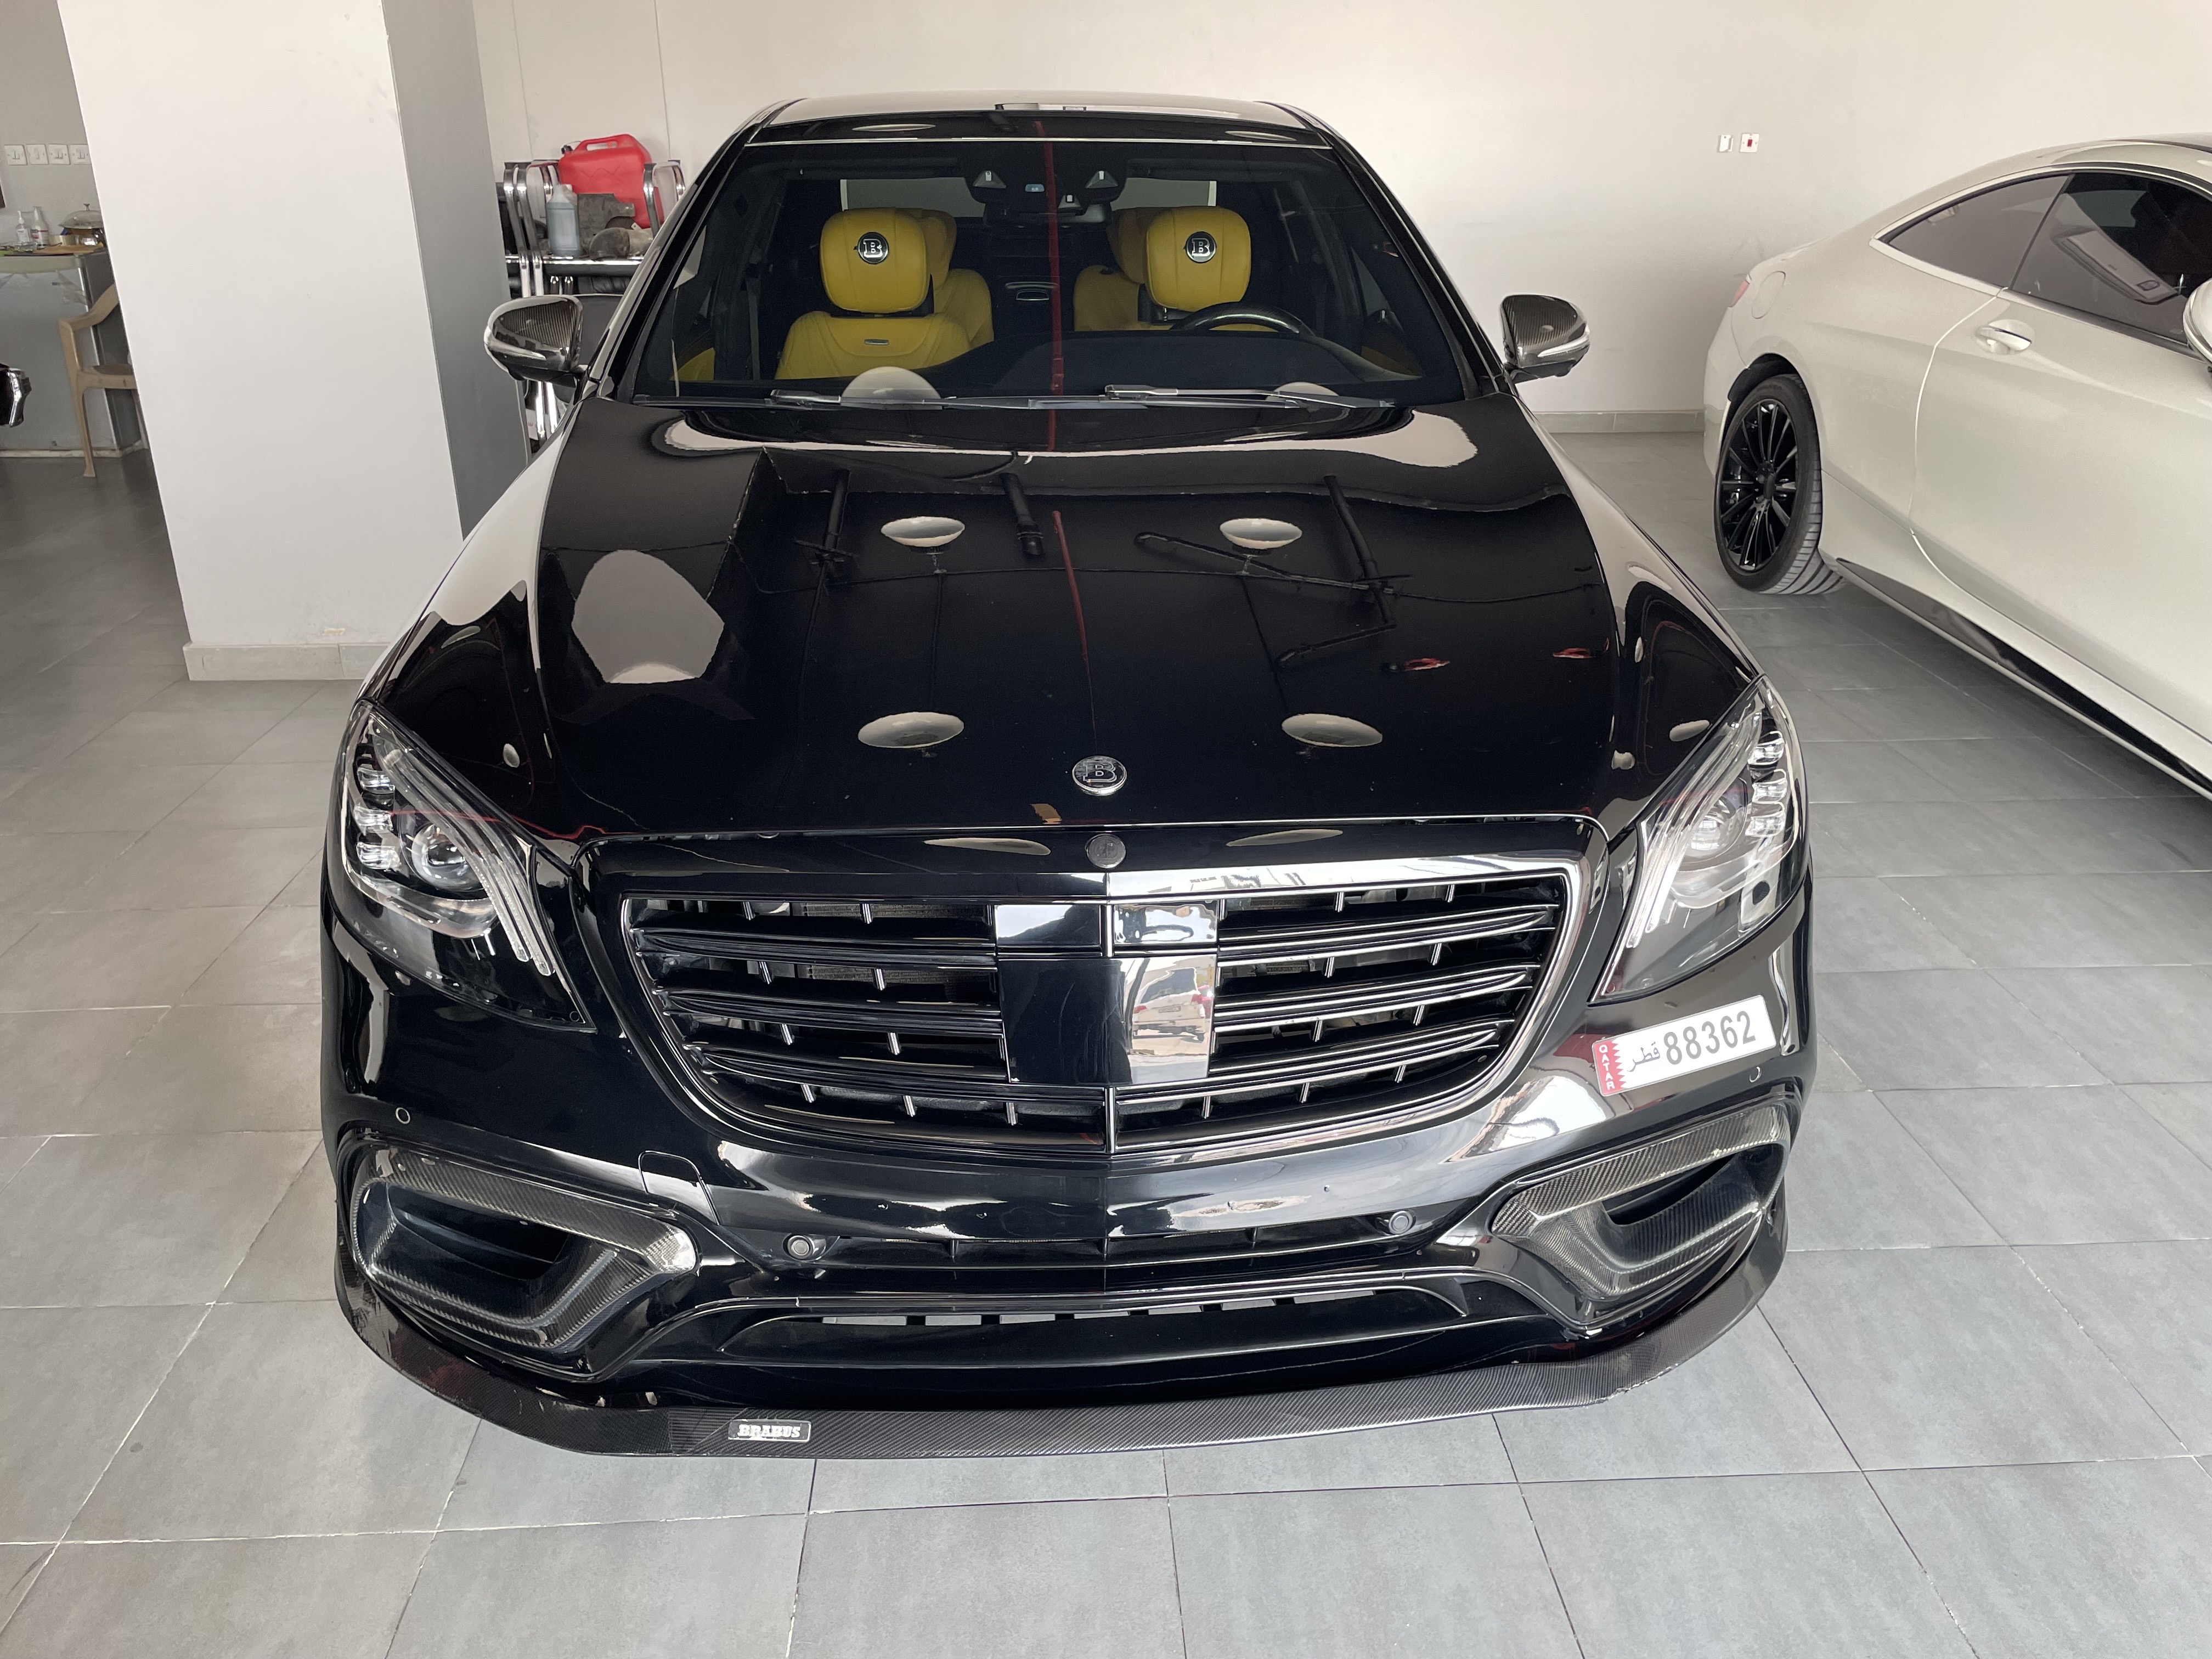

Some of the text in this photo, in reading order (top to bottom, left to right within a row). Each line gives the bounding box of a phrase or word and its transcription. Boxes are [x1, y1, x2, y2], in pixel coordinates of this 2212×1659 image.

[1627, 1041, 1660, 1072] قطر
[1663, 1011, 1756, 1065] 88362
[1599, 1044, 1615, 1090] QATAR
[737, 1424, 801, 1437] BRABUS
